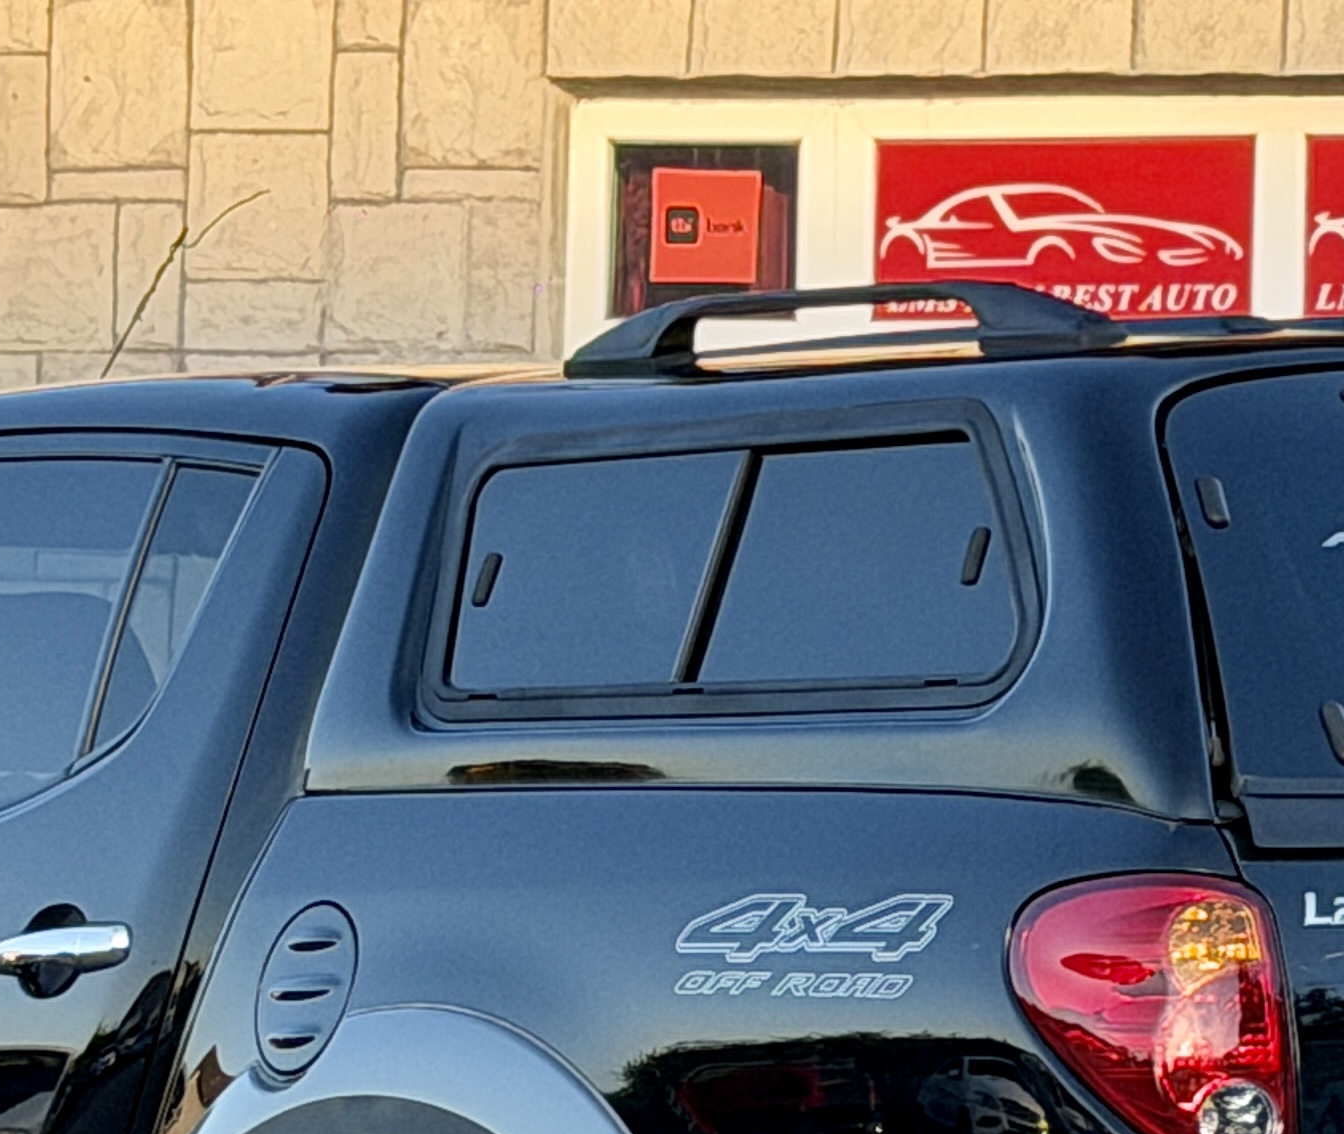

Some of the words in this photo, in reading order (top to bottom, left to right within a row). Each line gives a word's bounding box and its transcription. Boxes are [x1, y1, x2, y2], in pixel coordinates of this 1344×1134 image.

[706, 217, 745, 234] bank
[1142, 284, 1238, 313] AUTO
[675, 893, 954, 963] 4x4
[674, 970, 772, 996] OFF
[770, 972, 914, 1000] ROAD
